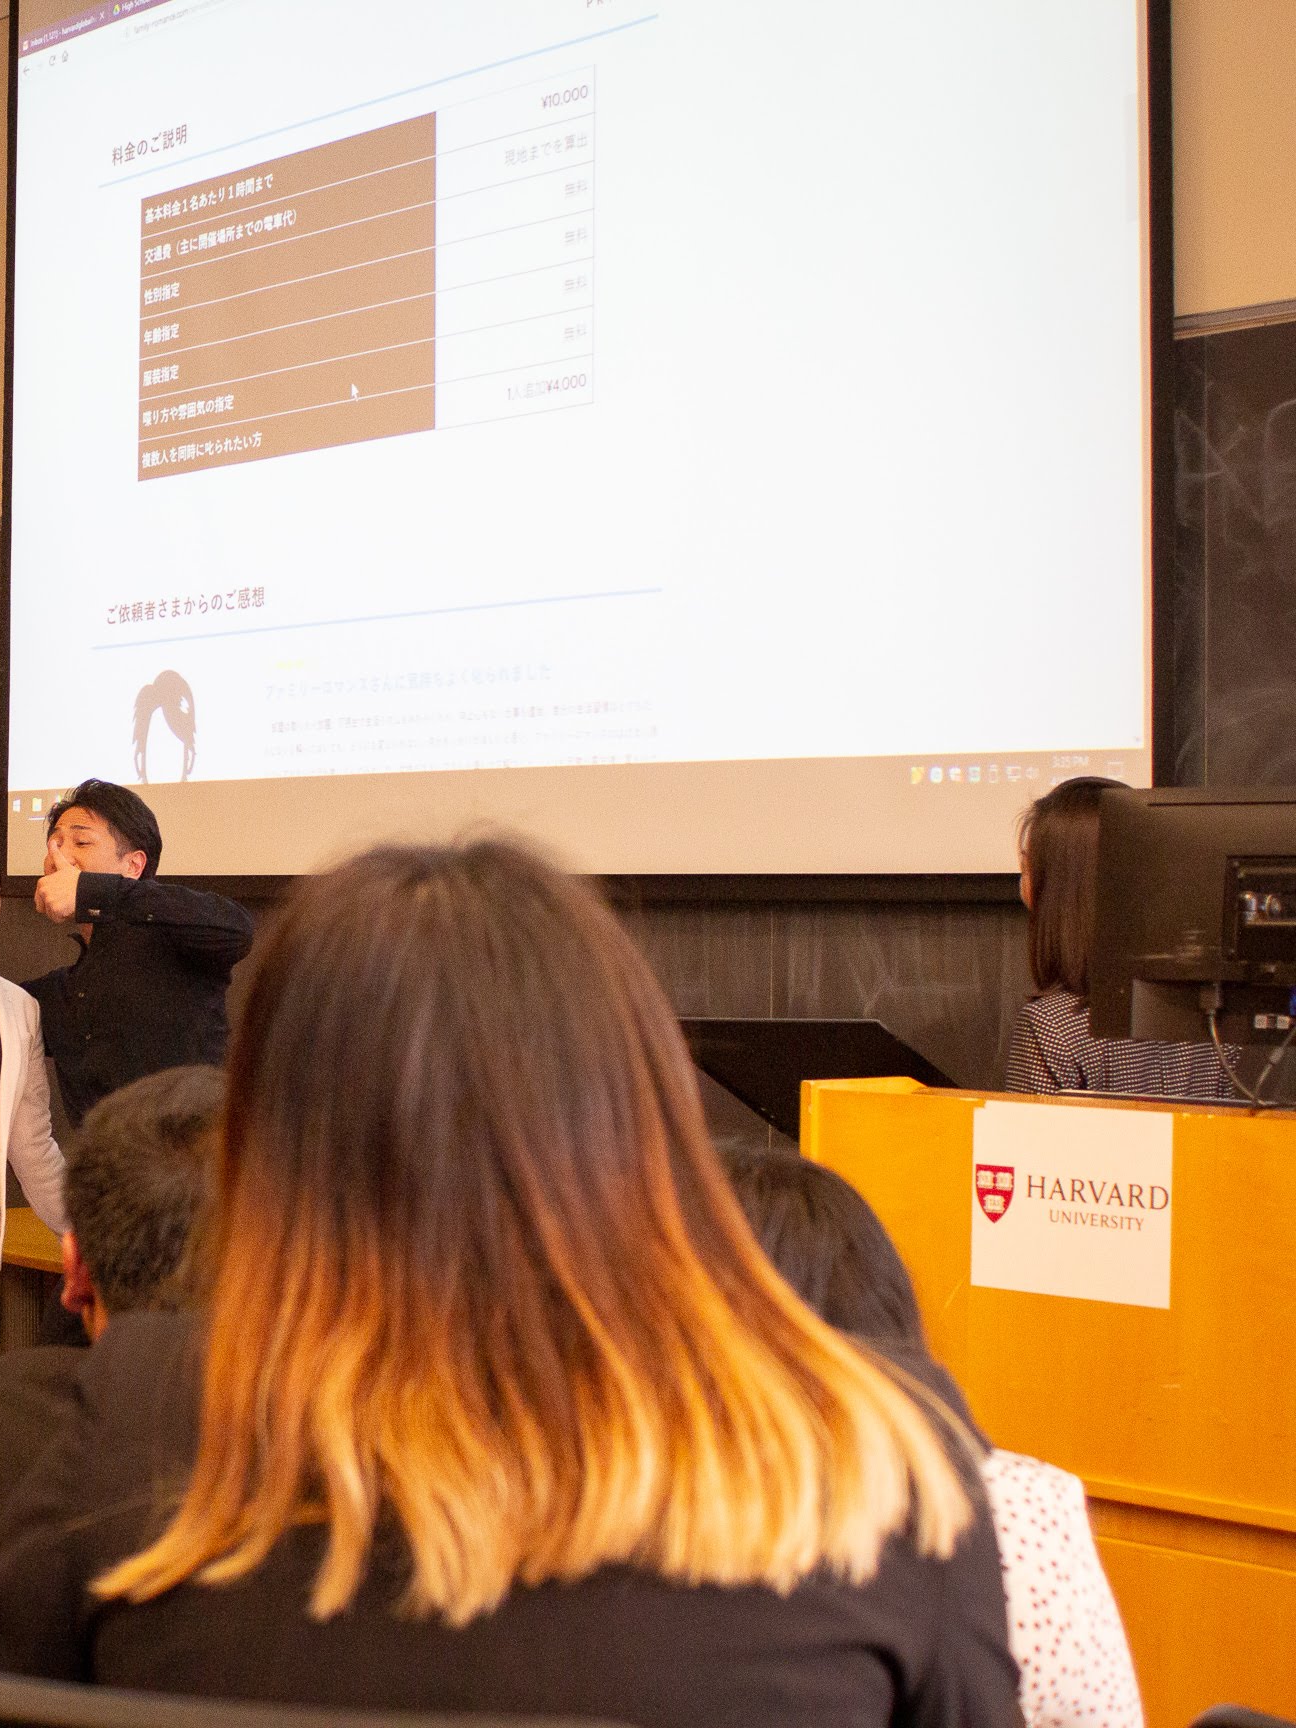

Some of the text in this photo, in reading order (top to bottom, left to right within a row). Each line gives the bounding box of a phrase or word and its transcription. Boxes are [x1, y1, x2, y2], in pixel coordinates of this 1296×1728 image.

[111, 124, 187, 166] 料金のご説明
[144, 282, 180, 306] 性別指定
[144, 323, 180, 346] 年齢指定
[107, 586, 265, 625] ご依頼者さまからのご感想
[1026, 1174, 1170, 1211] HARVARD
[1049, 1208, 1145, 1232] UNIVERSITY
